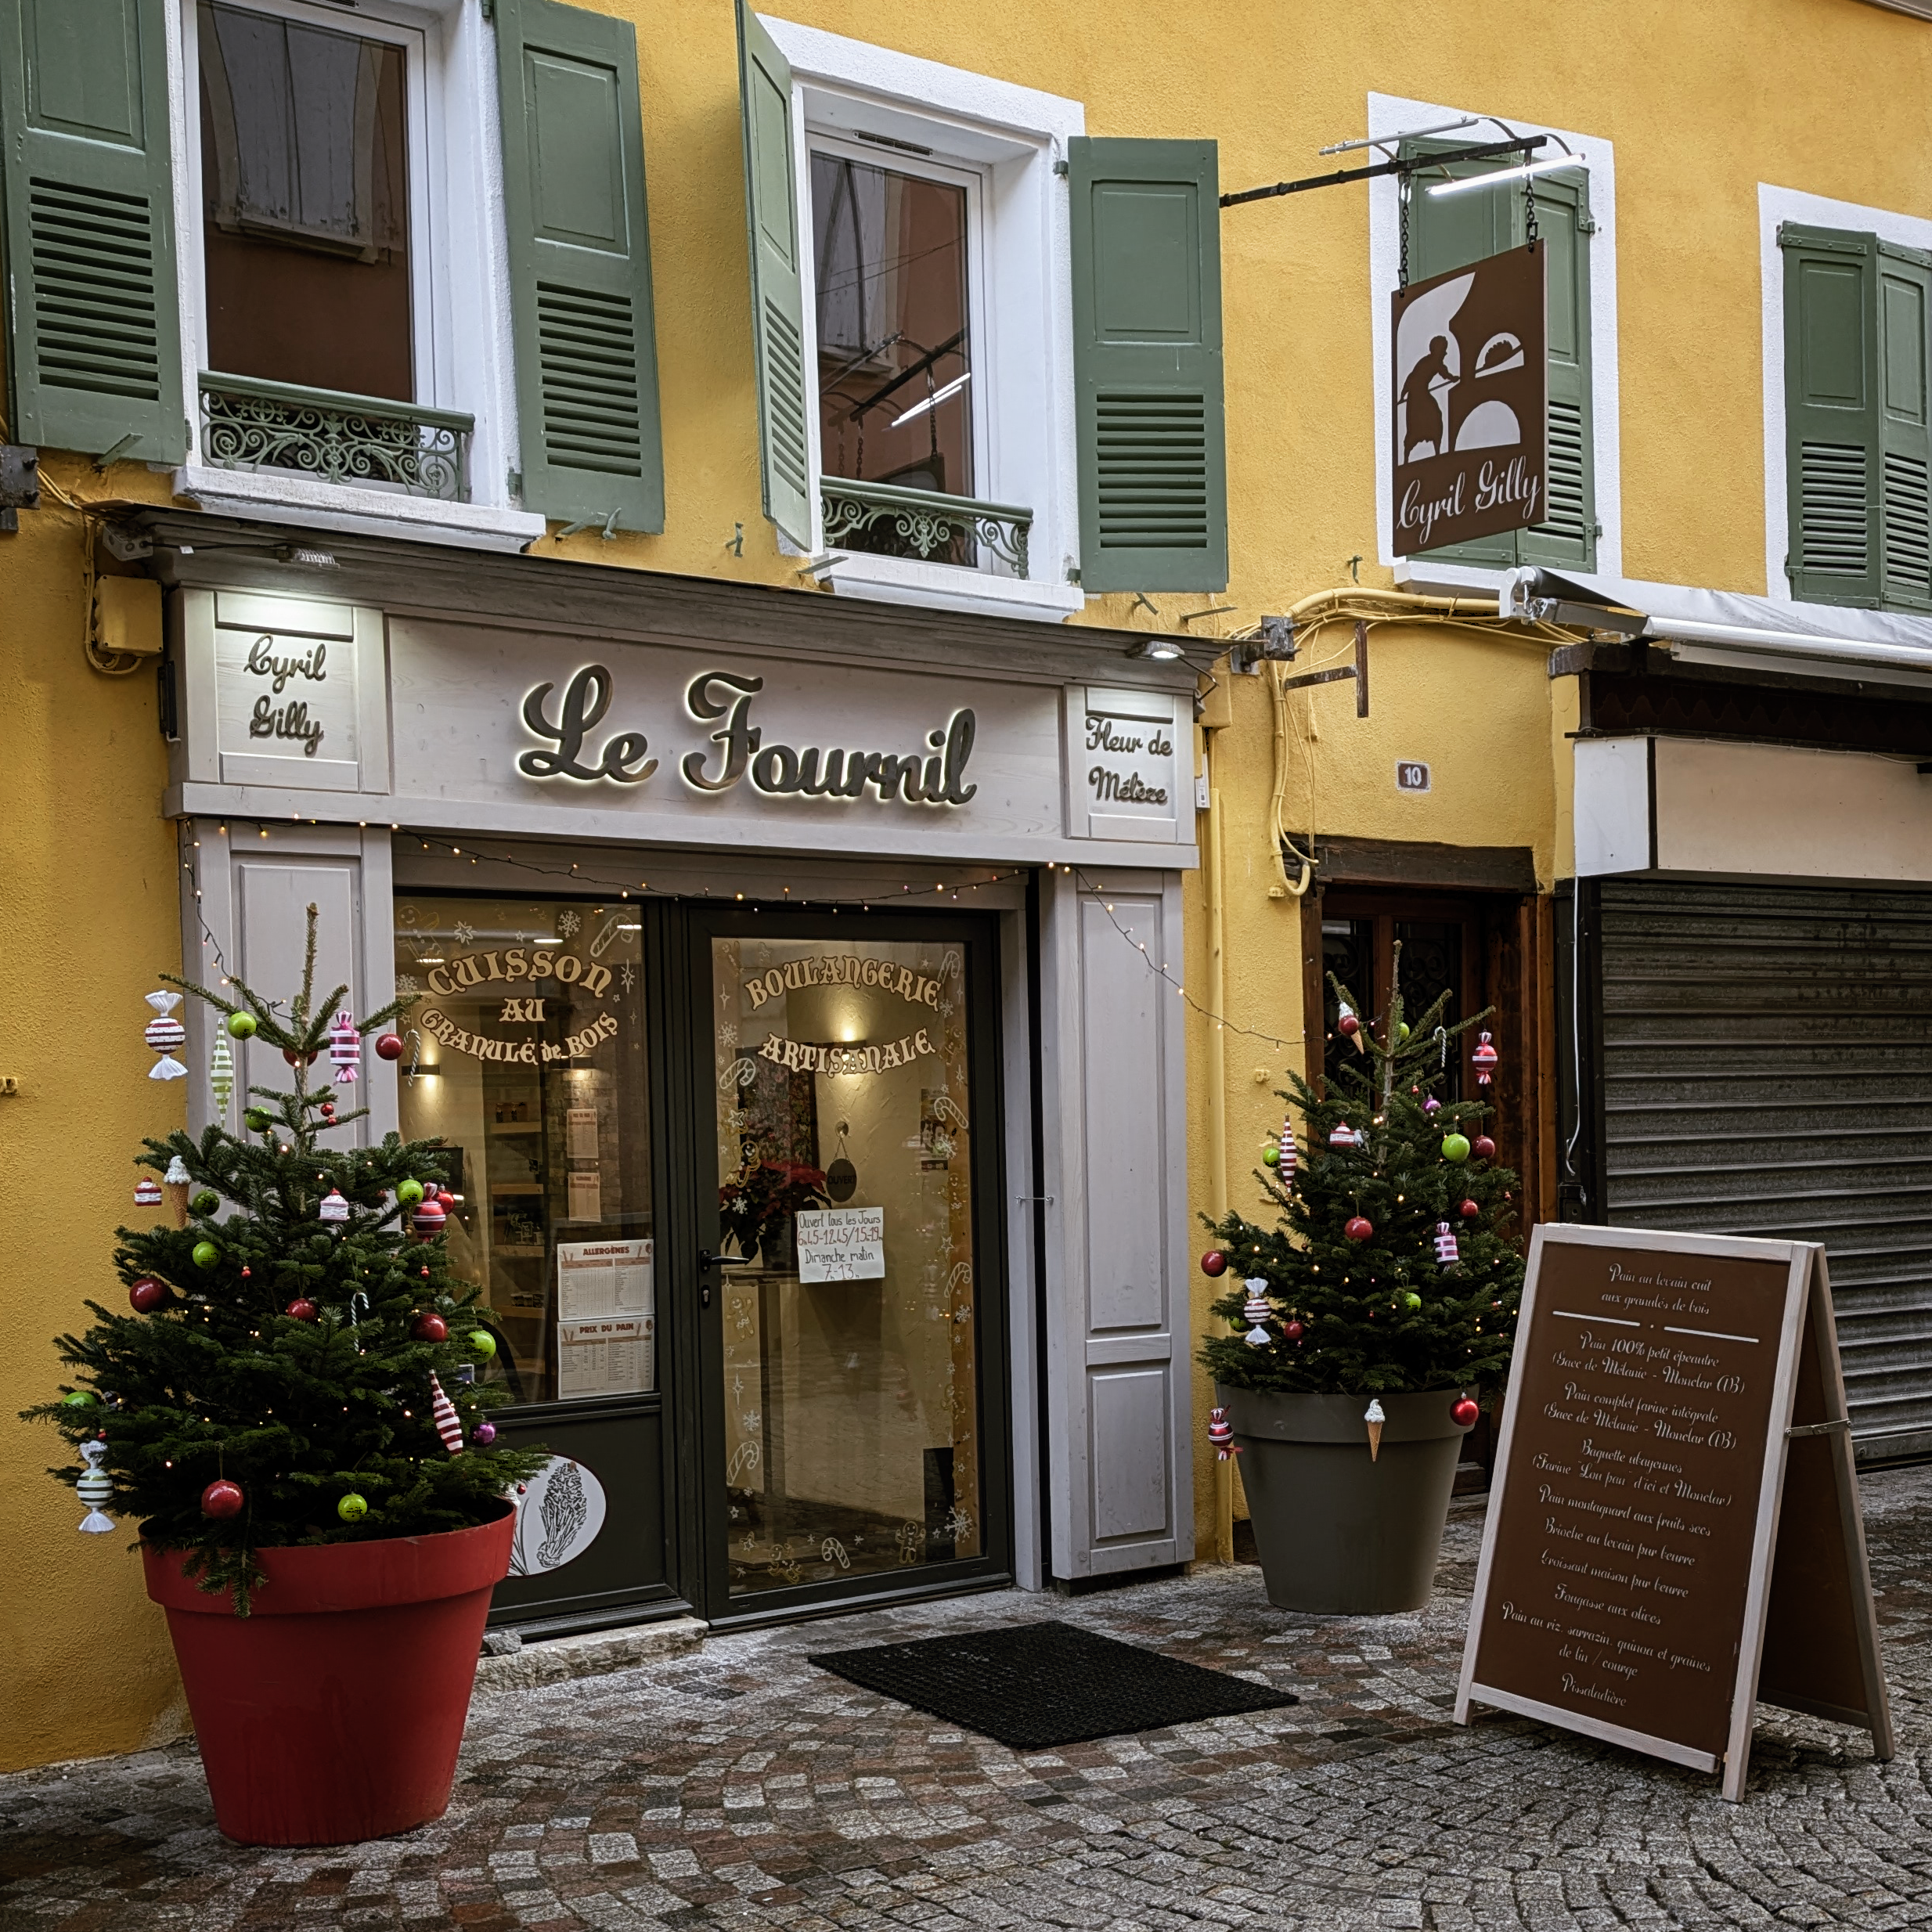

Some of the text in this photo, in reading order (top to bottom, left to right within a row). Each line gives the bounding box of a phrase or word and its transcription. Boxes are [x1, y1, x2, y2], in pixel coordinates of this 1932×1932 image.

[1397, 455, 1541, 545] Cyril Gilly
[243, 633, 326, 694] Cyril
[250, 695, 324, 754] Gilly
[517, 665, 978, 806] Le Fournil
[1085, 715, 1173, 756] Fleur de
[1404, 766, 1422, 786] 10
[427, 948, 612, 998] CUISSON
[745, 955, 942, 1012] BOULANGERIE
[499, 998, 546, 1022] AU
[420, 1008, 618, 1065] GRANULÉ de BOIS
[758, 1027, 936, 1078] ARTISANALE
[827, 1176, 856, 1184] OUVERT
[799, 1213, 824, 1228] Ouvert
[846, 1213, 856, 1225] les
[583, 1245, 629, 1256] ALLERGÈNES
[805, 1246, 874, 1264] Dimanche matin
[1609, 1263, 1635, 1281] Pain
[1638, 1275, 1653, 1284] au
[1656, 1271, 1687, 1288] levain
[1602, 1293, 1710, 1314] aux granulés de bois
[579, 1325, 597, 1334] PRIX
[616, 1323, 634, 1332] PAIN
[1580, 1331, 1719, 1367] Pain 100% petit épeautre
[1584, 1357, 1598, 1371] de
[1602, 1357, 1647, 1379] Mélanie
[1663, 1366, 1712, 1389] Monclar
[1565, 1382, 1718, 1426] Pain complet farine intégrale
[1576, 1410, 1588, 1423] de
[1593, 1409, 1638, 1433] Mélanie
[1654, 1419, 1704, 1444] Monclar
[1581, 1438, 1625, 1464] Baguette
[1660, 1483, 1670, 1494] et
[1539, 1484, 1710, 1537] Pain montagnard aux fruits secs
[1545, 1517, 1696, 1566] Brioche au levain pur beurre
[1541, 1548, 1689, 1598] Croissant maison pur beurre
[1555, 1583, 1661, 1625] Fougasse aux olives
[1502, 1601, 1526, 1622] Pain
[1530, 1616, 1543, 1627] au
[1617, 1639, 1653, 1656] quinoa
[1657, 1648, 1668, 1660] et
[1670, 1655, 1710, 1671] graines
[1559, 1645, 1572, 1658] de
[1575, 1645, 1588, 1663] lin
[1602, 1660, 1638, 1681] courge
[1562, 1672, 1627, 1707] Pissaladière
